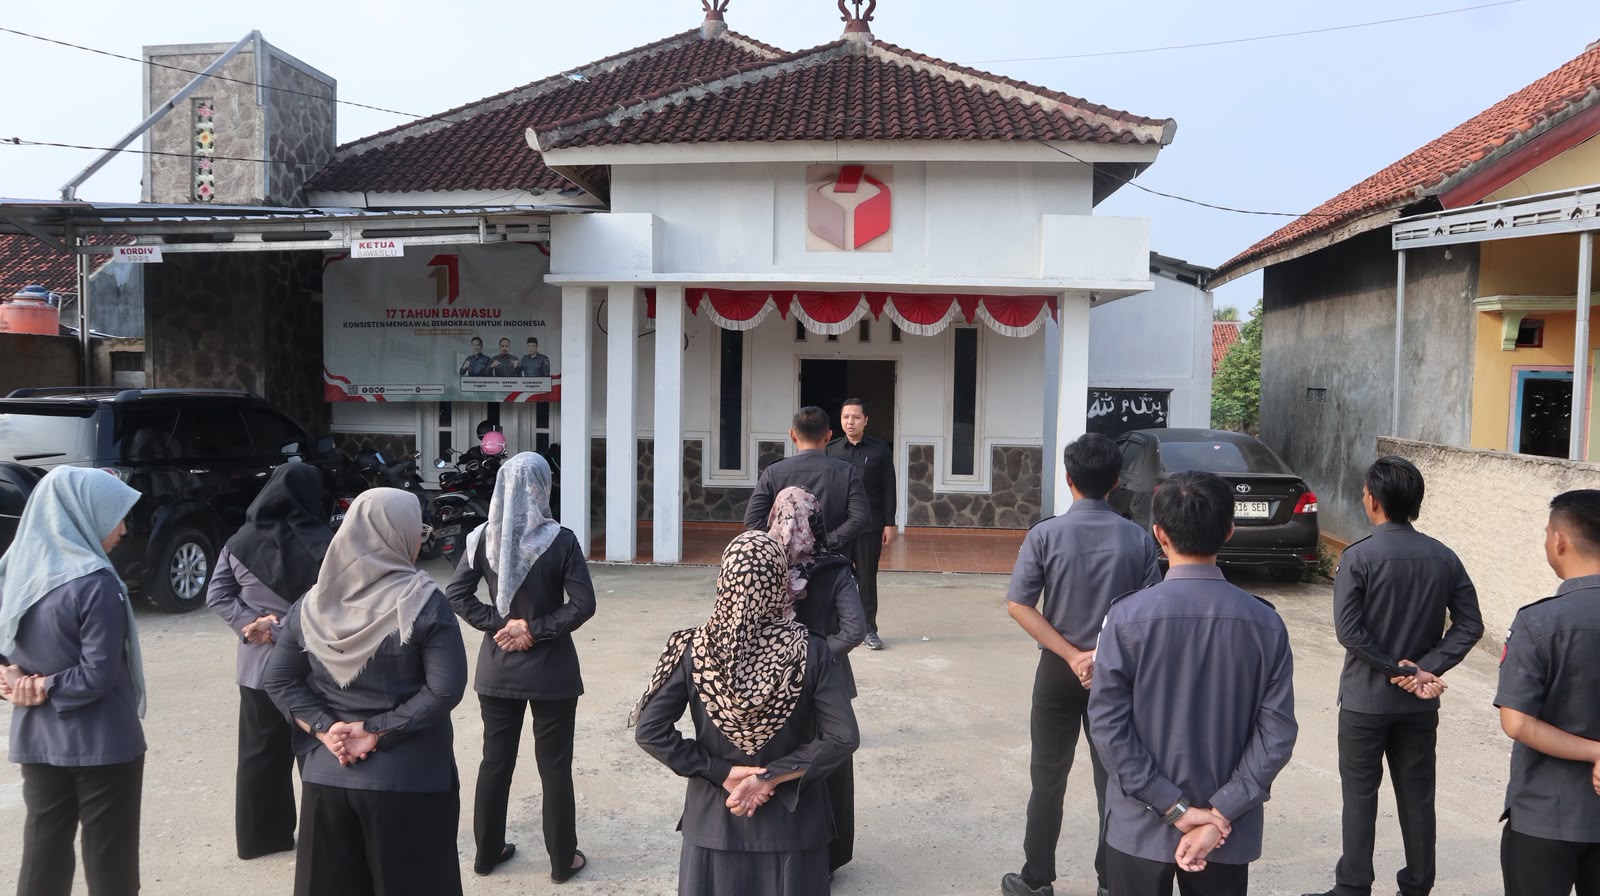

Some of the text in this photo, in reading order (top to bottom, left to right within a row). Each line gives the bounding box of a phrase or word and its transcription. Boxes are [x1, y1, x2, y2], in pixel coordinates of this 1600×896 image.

[359, 241, 396, 249] KETUA
[119, 247, 154, 255] KORDIV
[357, 249, 398, 257] BAWASLU
[385, 308, 501, 319] 17 TAHUN BAWASLU
[386, 320, 431, 328] MENGAWAL
[1251, 502, 1267, 512] SED
